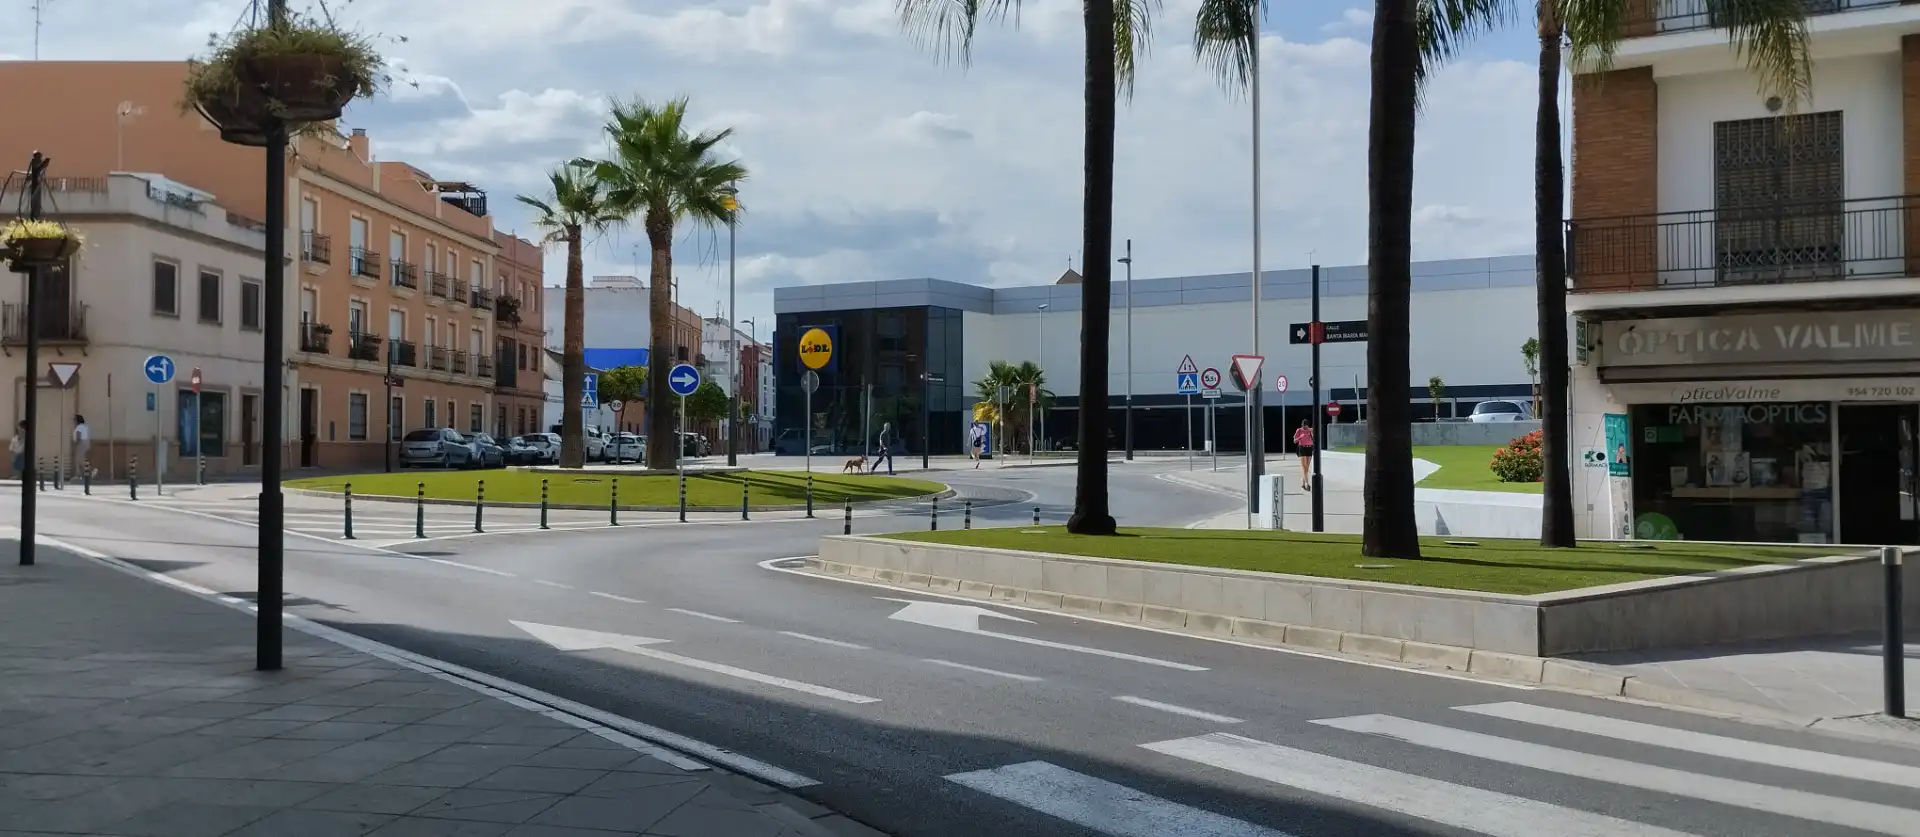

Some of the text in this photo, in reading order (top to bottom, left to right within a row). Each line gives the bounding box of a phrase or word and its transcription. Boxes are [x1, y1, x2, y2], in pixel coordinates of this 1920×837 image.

[1618, 322, 1913, 356] ÓPTICA VALME
[1278, 380, 1285, 388] 20
[1871, 387, 1892, 396] 720
[1896, 386, 1915, 396] 102
[1668, 404, 1827, 425] FARMAOPTICS
